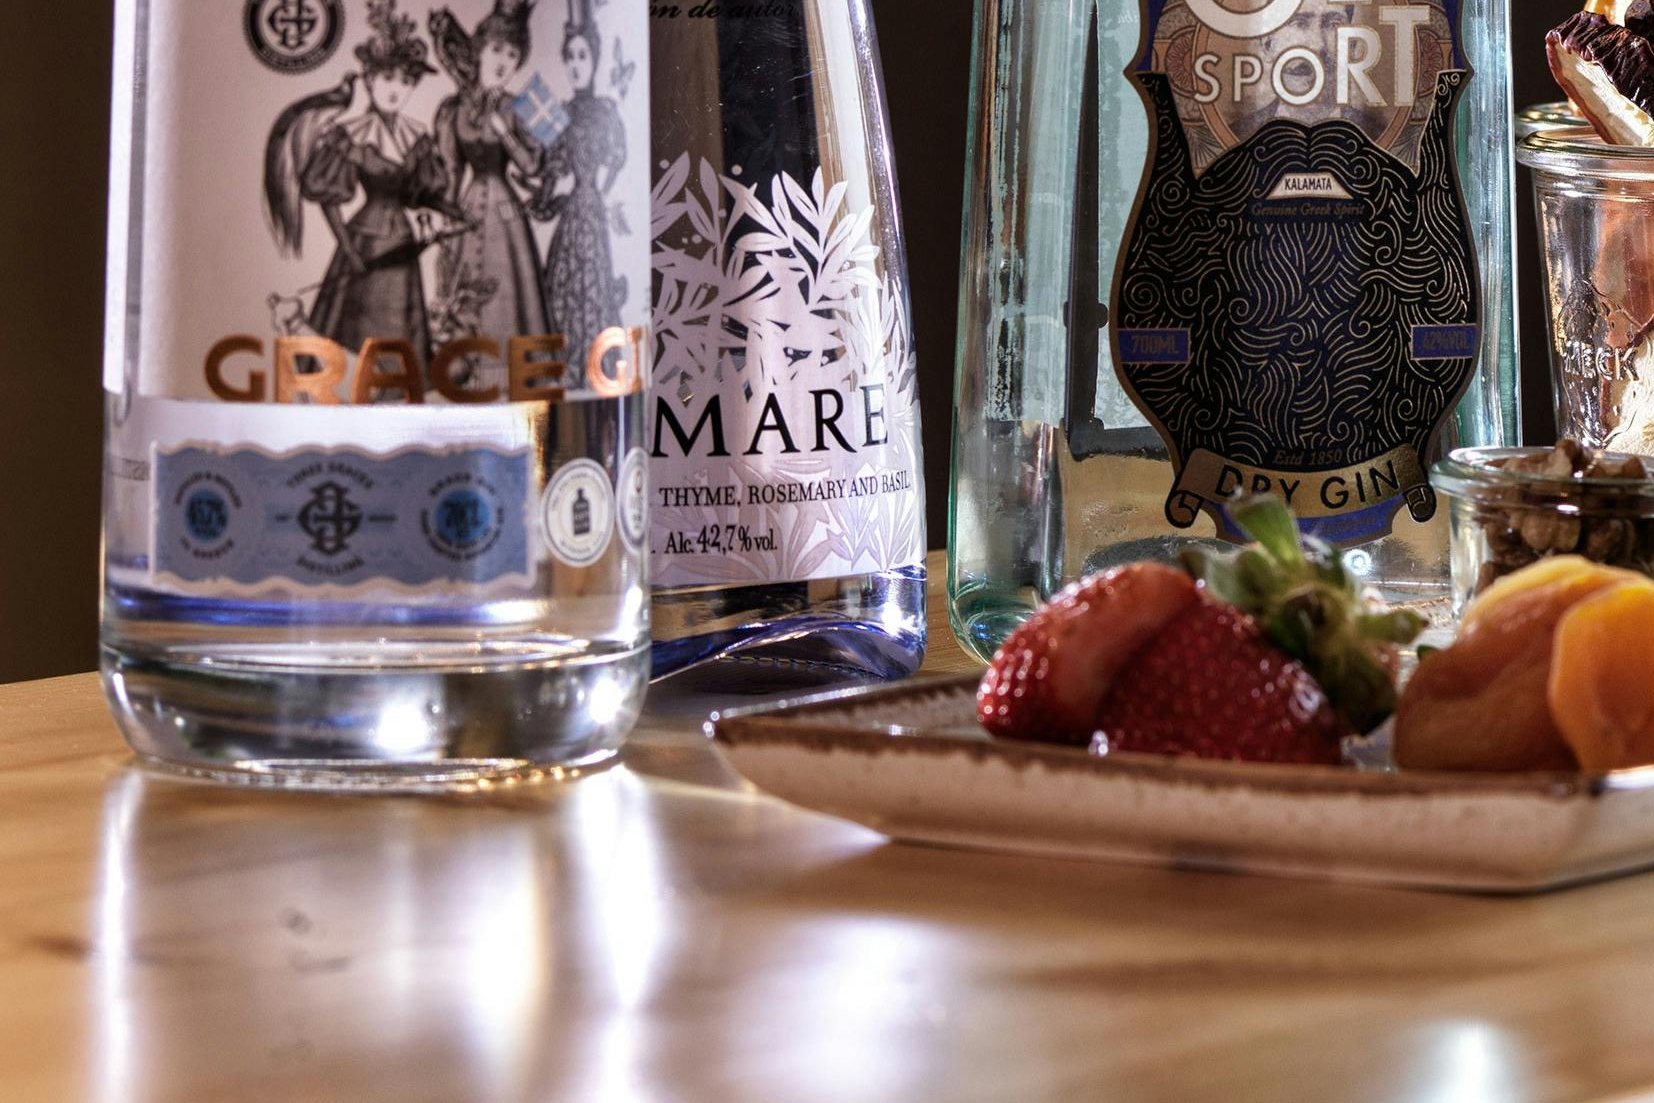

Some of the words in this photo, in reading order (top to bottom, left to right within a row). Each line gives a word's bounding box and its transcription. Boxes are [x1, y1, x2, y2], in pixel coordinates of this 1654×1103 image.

[1192, 4, 1432, 109] SPORT
[1284, 178, 1332, 191] KALAMATA
[1252, 202, 1297, 217] Genuine
[1300, 202, 1331, 217] Greek
[1334, 202, 1365, 219] Spirit
[204, 333, 566, 405] GRACE
[588, 324, 648, 397] GI
[1131, 334, 1180, 355] 700ML
[651, 382, 889, 458] MARE
[748, 478, 846, 505] ROSEMARY
[849, 475, 878, 498] AND
[1320, 459, 1401, 510] GIN
